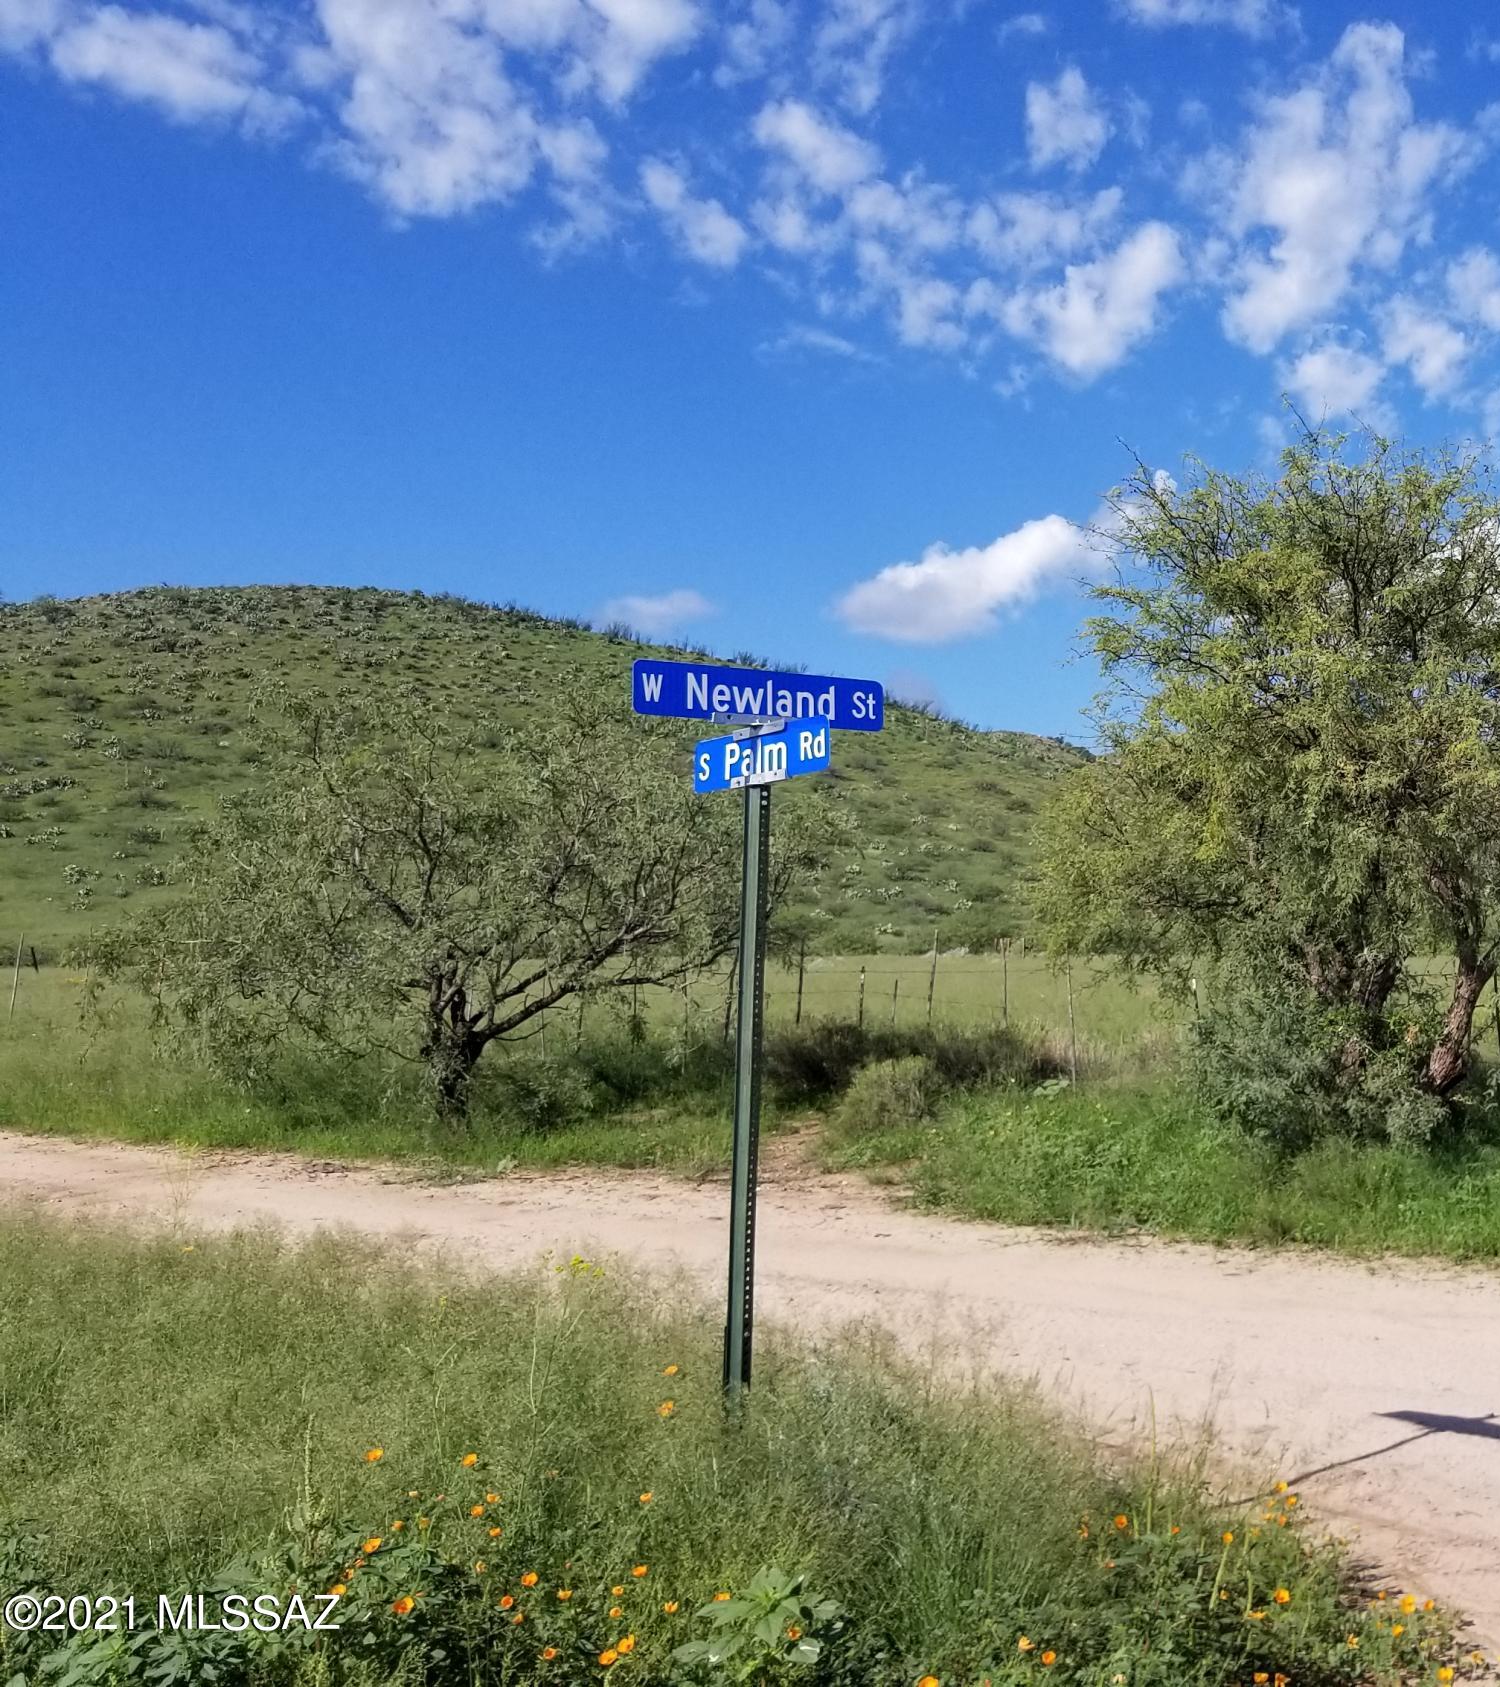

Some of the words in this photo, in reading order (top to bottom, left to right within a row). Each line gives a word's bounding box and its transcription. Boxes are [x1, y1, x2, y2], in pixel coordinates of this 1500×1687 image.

[642, 673, 663, 703] W
[686, 672, 836, 721] Newland
[852, 691, 877, 720] St
[698, 753, 711, 782] S
[724, 737, 788, 781] Palm
[800, 728, 826, 762] Rd
